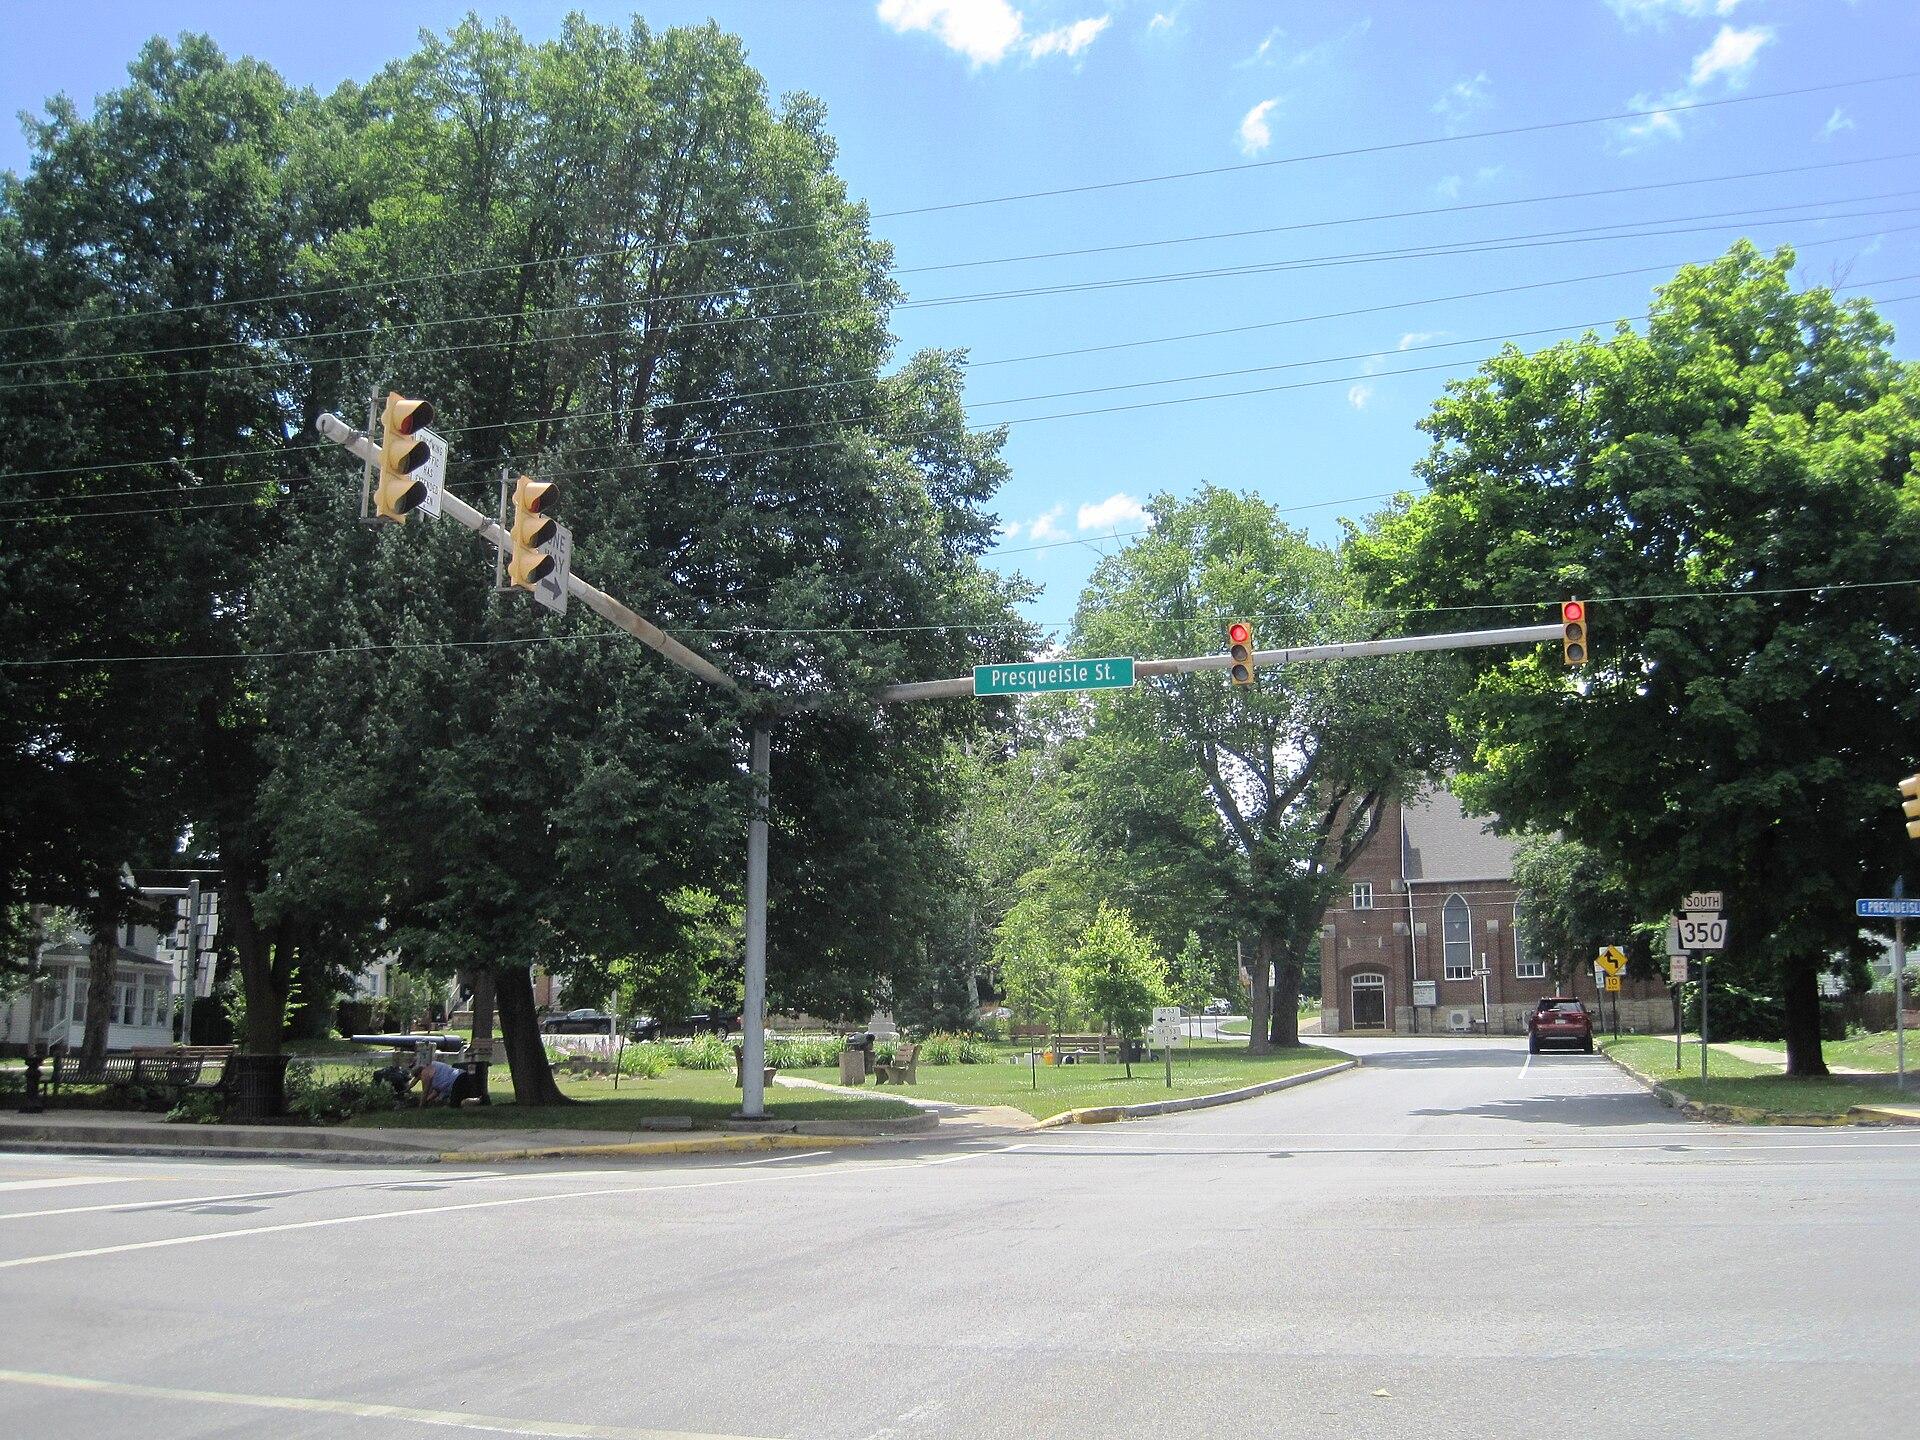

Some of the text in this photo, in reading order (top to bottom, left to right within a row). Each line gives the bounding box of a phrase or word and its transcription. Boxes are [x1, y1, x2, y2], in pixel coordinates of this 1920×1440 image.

[992, 663, 1116, 689] Presqueisle St.
[1686, 896, 1720, 907] SOUTH
[1861, 903, 1867, 912] E
[1684, 922, 1723, 943] 350
[1608, 978, 1618, 986] 10
